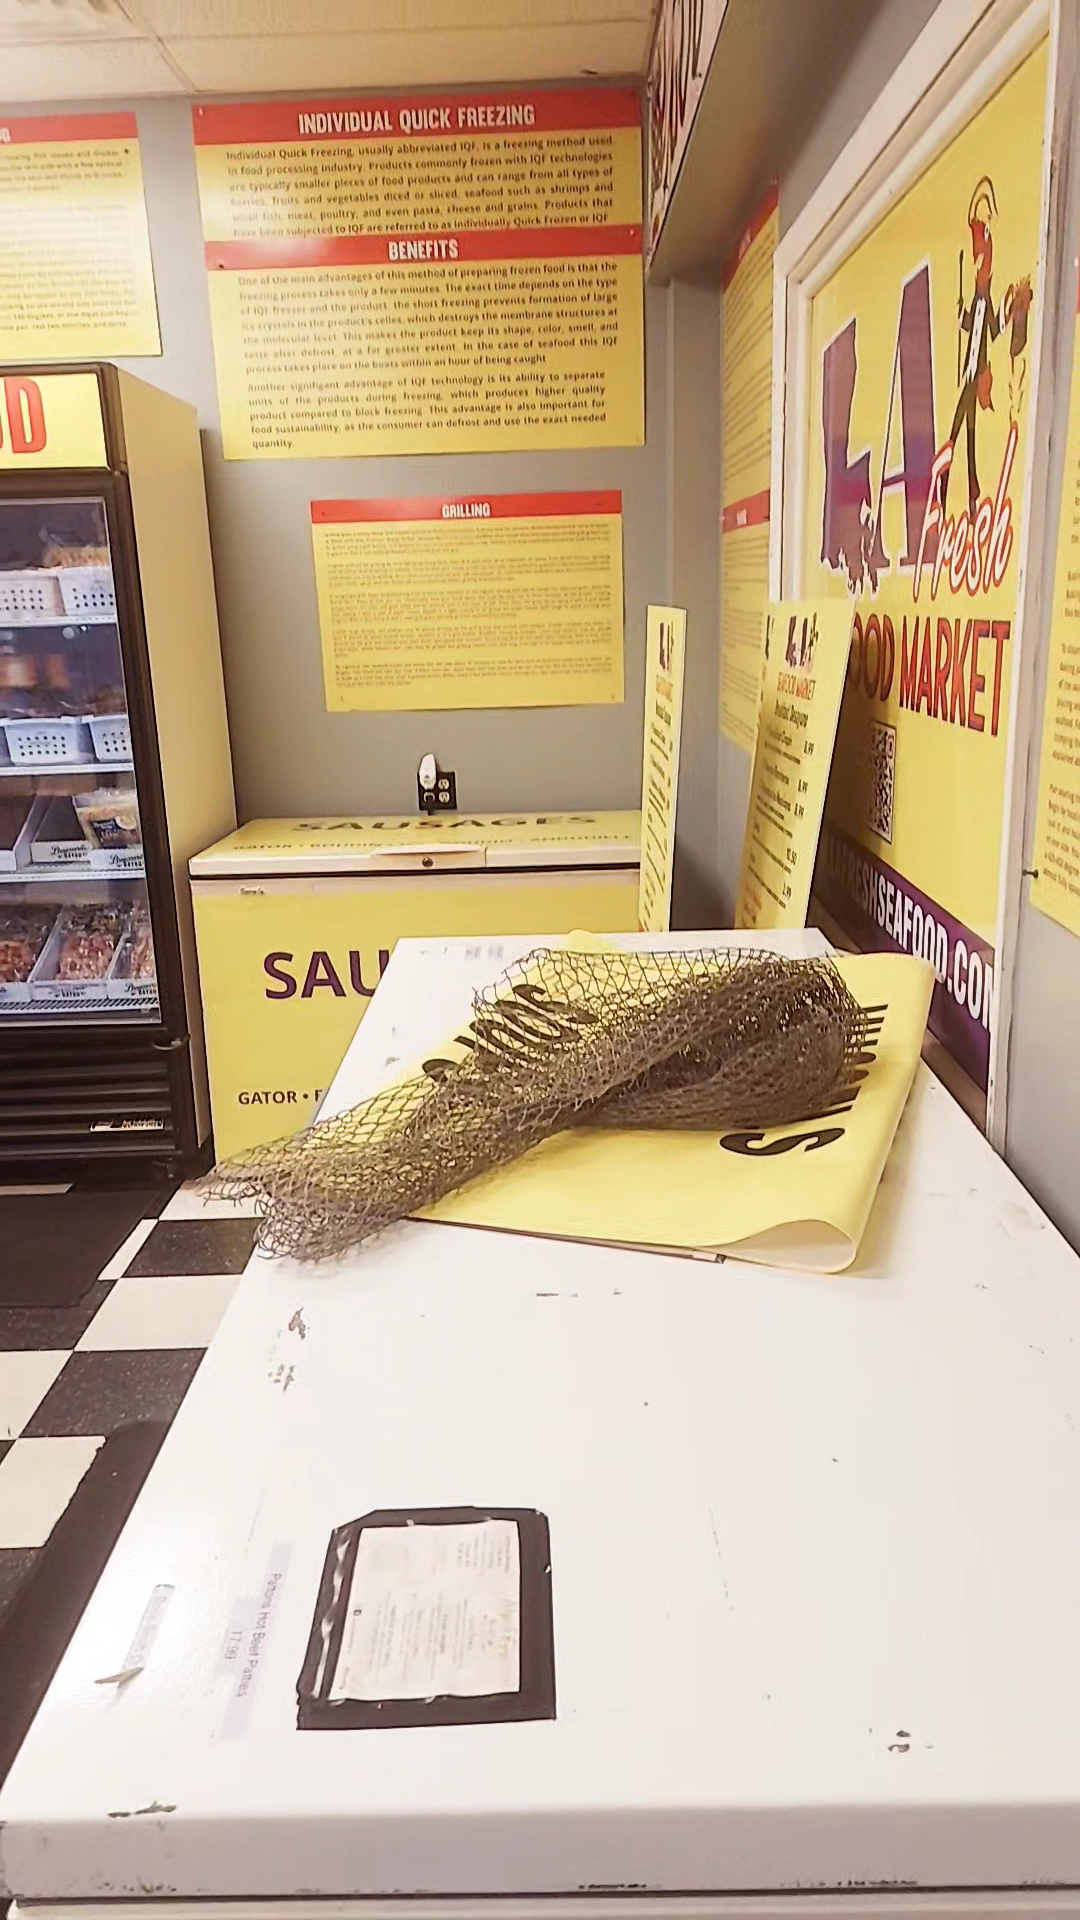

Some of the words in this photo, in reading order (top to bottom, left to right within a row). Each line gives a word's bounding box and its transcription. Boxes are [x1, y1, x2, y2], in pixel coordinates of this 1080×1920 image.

[298, 108, 393, 134] INDIVIDUAL
[400, 107, 450, 131] QUICK
[457, 104, 535, 128] FREEZING
[279, 148, 306, 159] Quick
[358, 145, 393, 156] usually
[397, 142, 456, 153] abbreviated
[503, 139, 543, 150] freezing
[546, 137, 585, 147] method
[588, 136, 612, 145] used
[240, 165, 262, 175] food
[266, 164, 318, 176] processing
[368, 160, 412, 170] Products
[415, 158, 466, 169] commonly
[470, 156, 501, 166] frozen
[505, 155, 526, 164] with
[530, 154, 544, 165] IQF
[550, 152, 612, 164] technologies
[294, 179, 329, 188] smaller
[334, 178, 364, 189] pieces
[381, 176, 403, 185] food
[407, 174, 450, 186] products
[454, 174, 472, 182] and
[497, 172, 525, 182] range
[529, 169, 553, 179] from
[557, 168, 568, 178] all
[572, 168, 599, 179] types
[464, 187, 503, 197] seafood
[507, 186, 530, 195] such
[550, 184, 589, 195] shrimps
[594, 182, 612, 191] and
[348, 223, 362, 234] IQF
[385, 221, 425, 230] referred
[454, 218, 509, 230] Individually
[513, 216, 540, 227] Quick
[544, 215, 576, 224] Frozen
[592, 213, 606, 224] IQF
[387, 238, 460, 262] BENEFITS
[318, 272, 372, 284] advantages
[387, 270, 404, 279] this
[408, 269, 445, 278] method
[460, 267, 507, 278] preparing
[510, 266, 540, 274] frozen
[543, 264, 564, 273] food
[578, 263, 597, 272] that
[601, 262, 616, 271] the
[441, 298, 480, 309] freezing
[483, 296, 525, 307] prevents
[529, 294, 577, 303] formation
[593, 292, 617, 303] large
[407, 314, 435, 323] which
[438, 313, 478, 324] destroys
[482, 312, 497, 320] the
[500, 310, 552, 319] membrane
[556, 308, 605, 318] structures
[400, 330, 414, 338] the
[419, 328, 456, 339] product
[460, 327, 483, 337] keep
[487, 326, 498, 335] its
[600, 322, 618, 330] and
[0, 376, 47, 454] D
[249, 411, 286, 422] product
[290, 409, 337, 420] compared
[355, 407, 379, 416] block
[429, 405, 447, 413] This
[452, 403, 500, 414] advantage
[517, 402, 535, 410] also
[539, 400, 586, 411] important
[591, 399, 604, 408] for
[251, 425, 272, 434] food
[358, 422, 373, 430] the
[376, 421, 421, 429] consumer
[426, 420, 442, 428] can
[446, 418, 479, 427] defrost
[483, 417, 500, 426] and
[523, 416, 539, 424] the
[542, 415, 567, 423] exact
[571, 414, 606, 422] needed
[441, 502, 491, 519] GRILLING
[912, 422, 1017, 603] Fresh
[898, 614, 1011, 738] MARKET
[293, 815, 596, 832] SAUSAGES
[238, 1090, 298, 1106] GATOR
